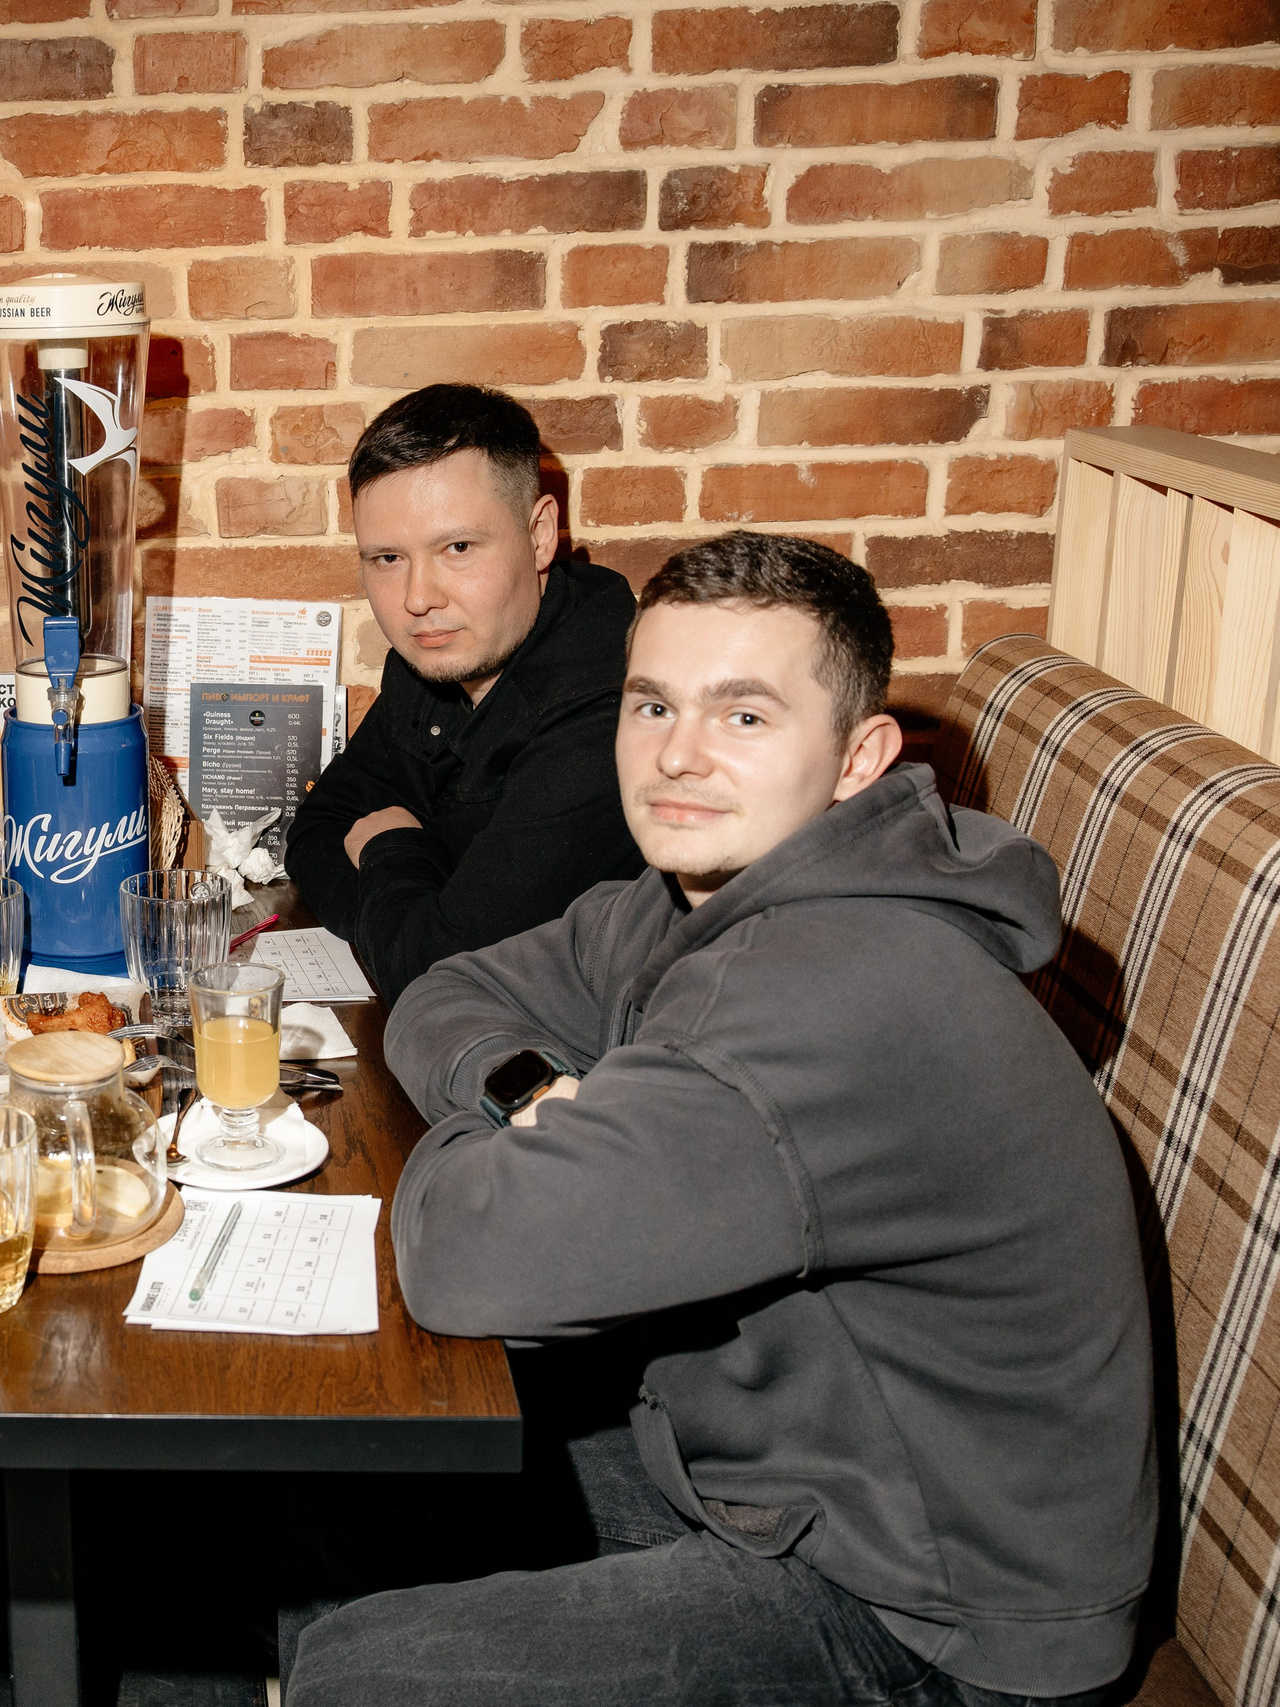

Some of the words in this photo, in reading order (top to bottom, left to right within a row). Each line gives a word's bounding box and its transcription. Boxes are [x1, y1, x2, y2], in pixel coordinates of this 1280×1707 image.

[5, 294, 37, 306] quality
[30, 307, 52, 318] BEER
[230, 693, 270, 703] ИМПОРТ
[272, 694, 280, 703] И
[282, 694, 310, 703] КРАФТ
[4, 805, 146, 884] Жигули
